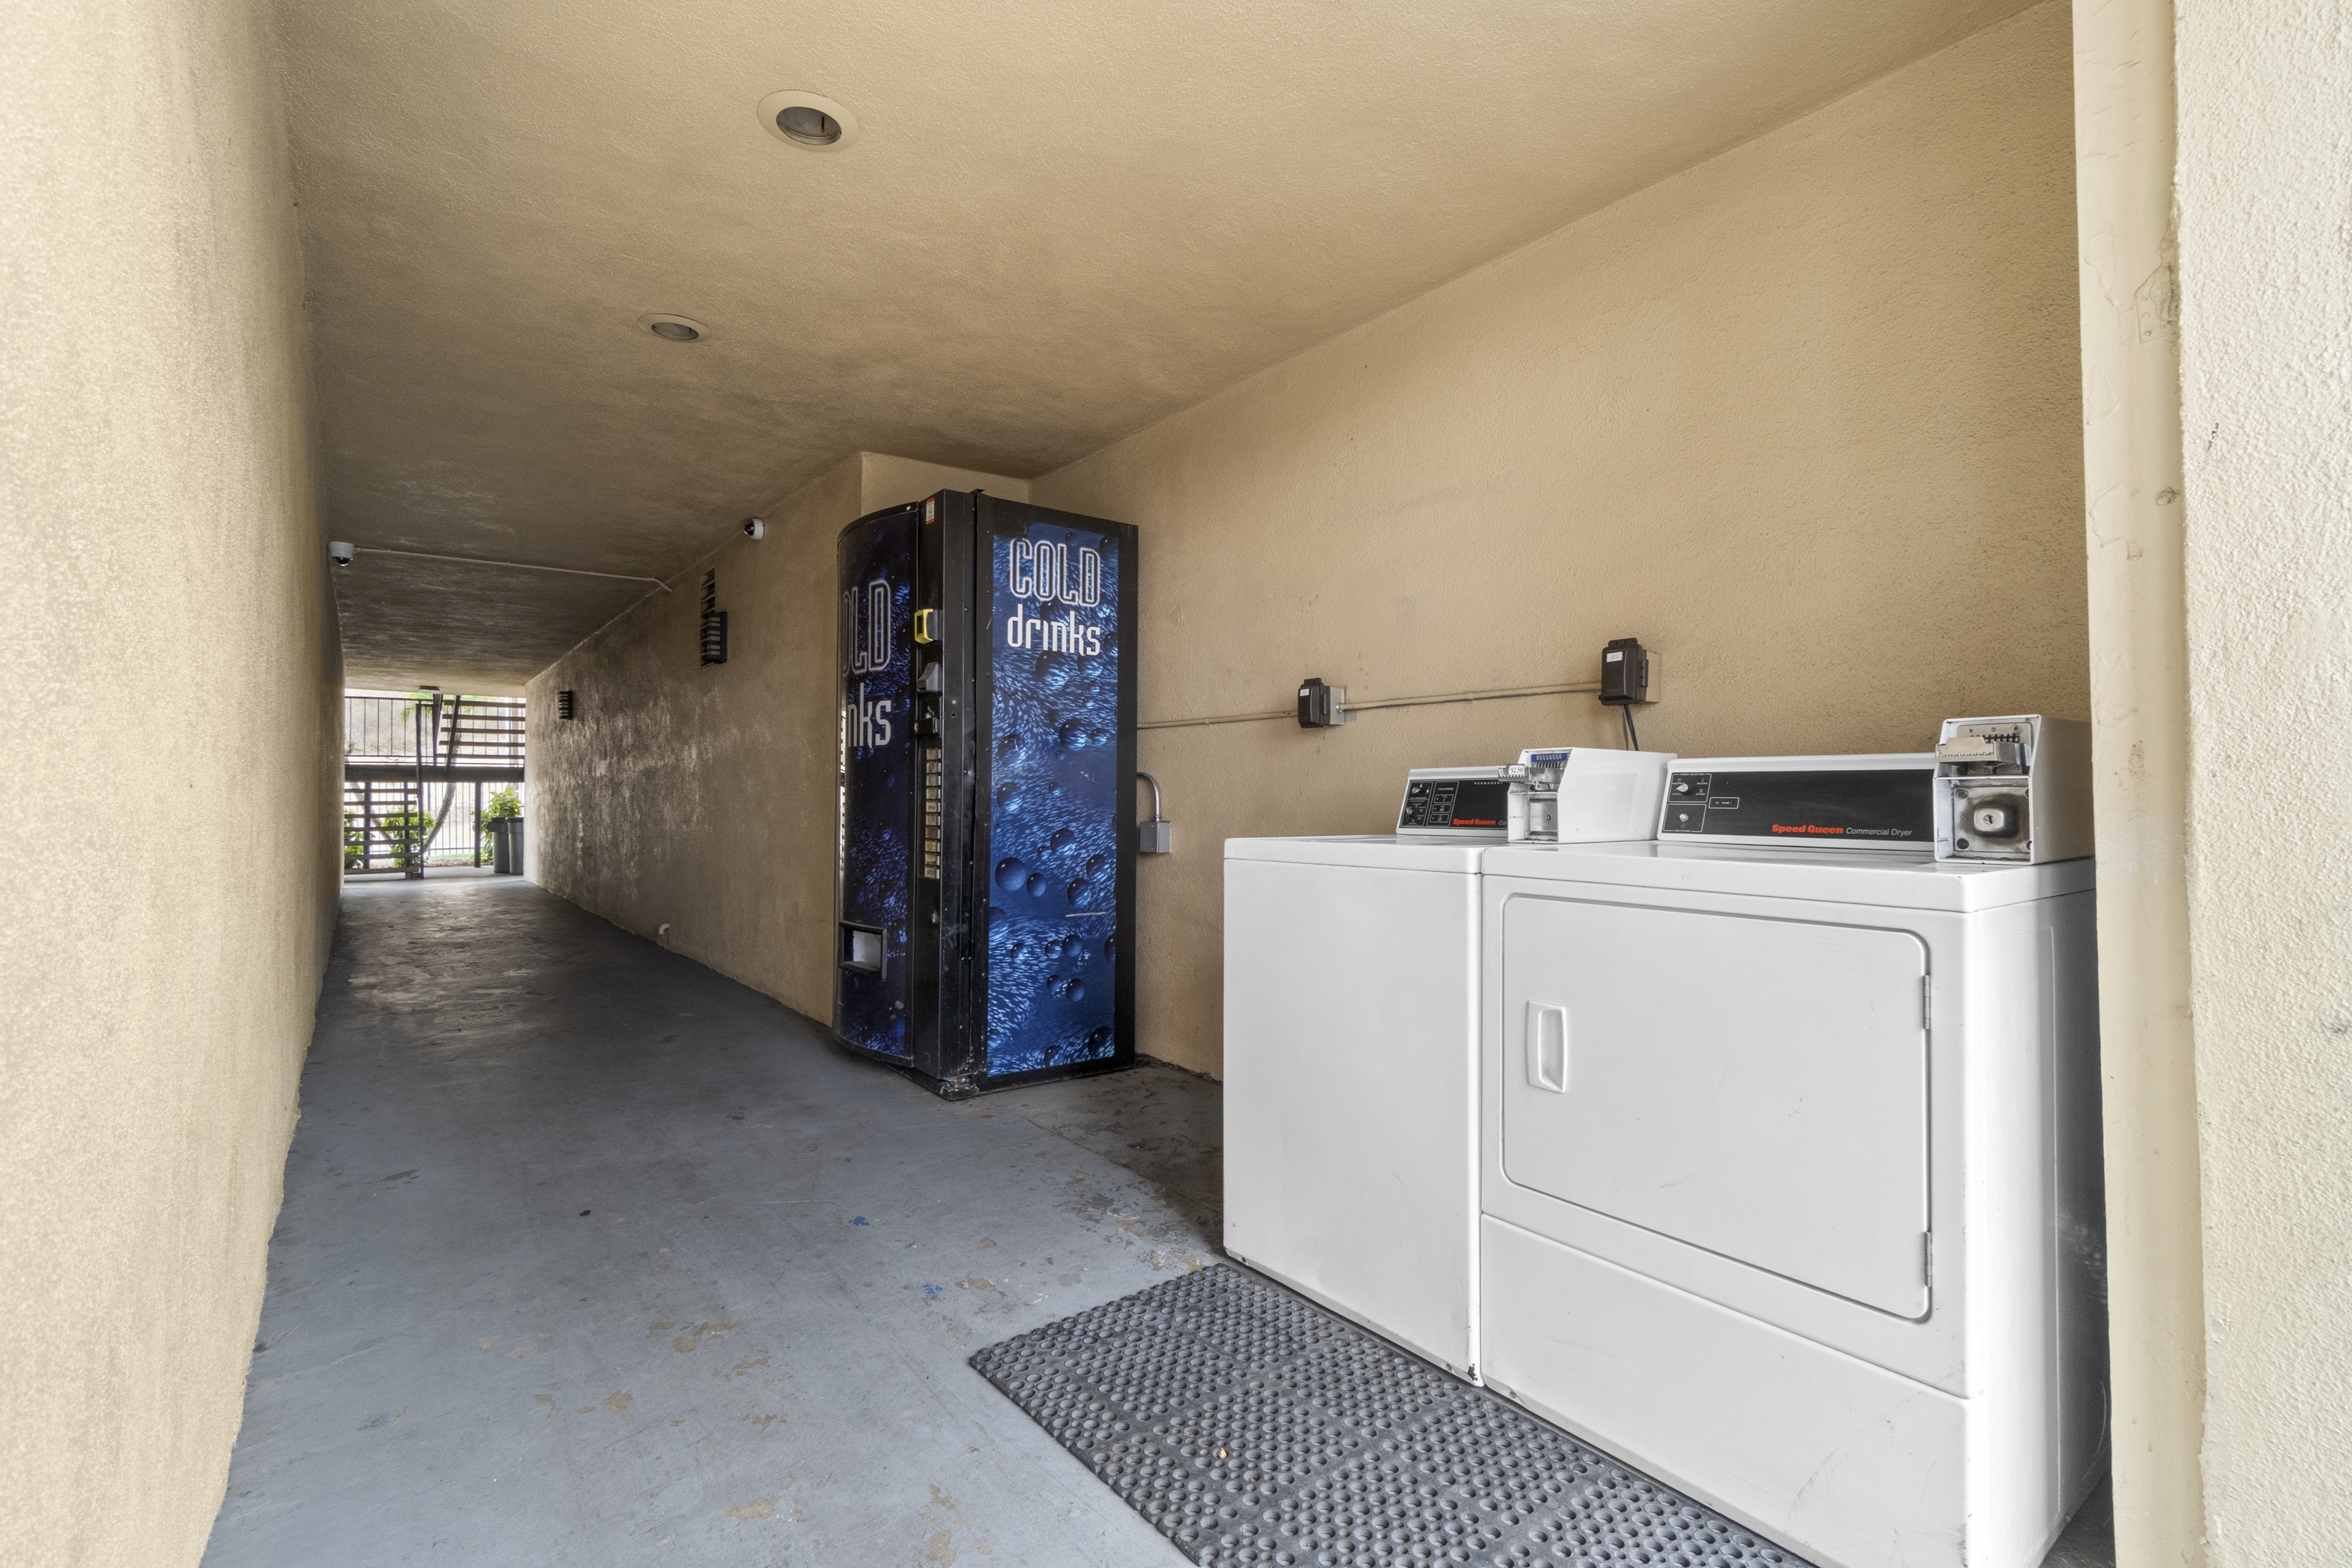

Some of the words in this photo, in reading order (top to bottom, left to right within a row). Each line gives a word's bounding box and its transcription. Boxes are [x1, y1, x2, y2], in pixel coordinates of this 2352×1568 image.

[1010, 537, 1100, 607] COLD
[1007, 603, 1101, 656] drinks
[1772, 824, 1806, 833] Speed
[1807, 825, 1844, 834] Queen
[1846, 827, 1889, 836] Commercial
[1891, 828, 1913, 837] Dryer
